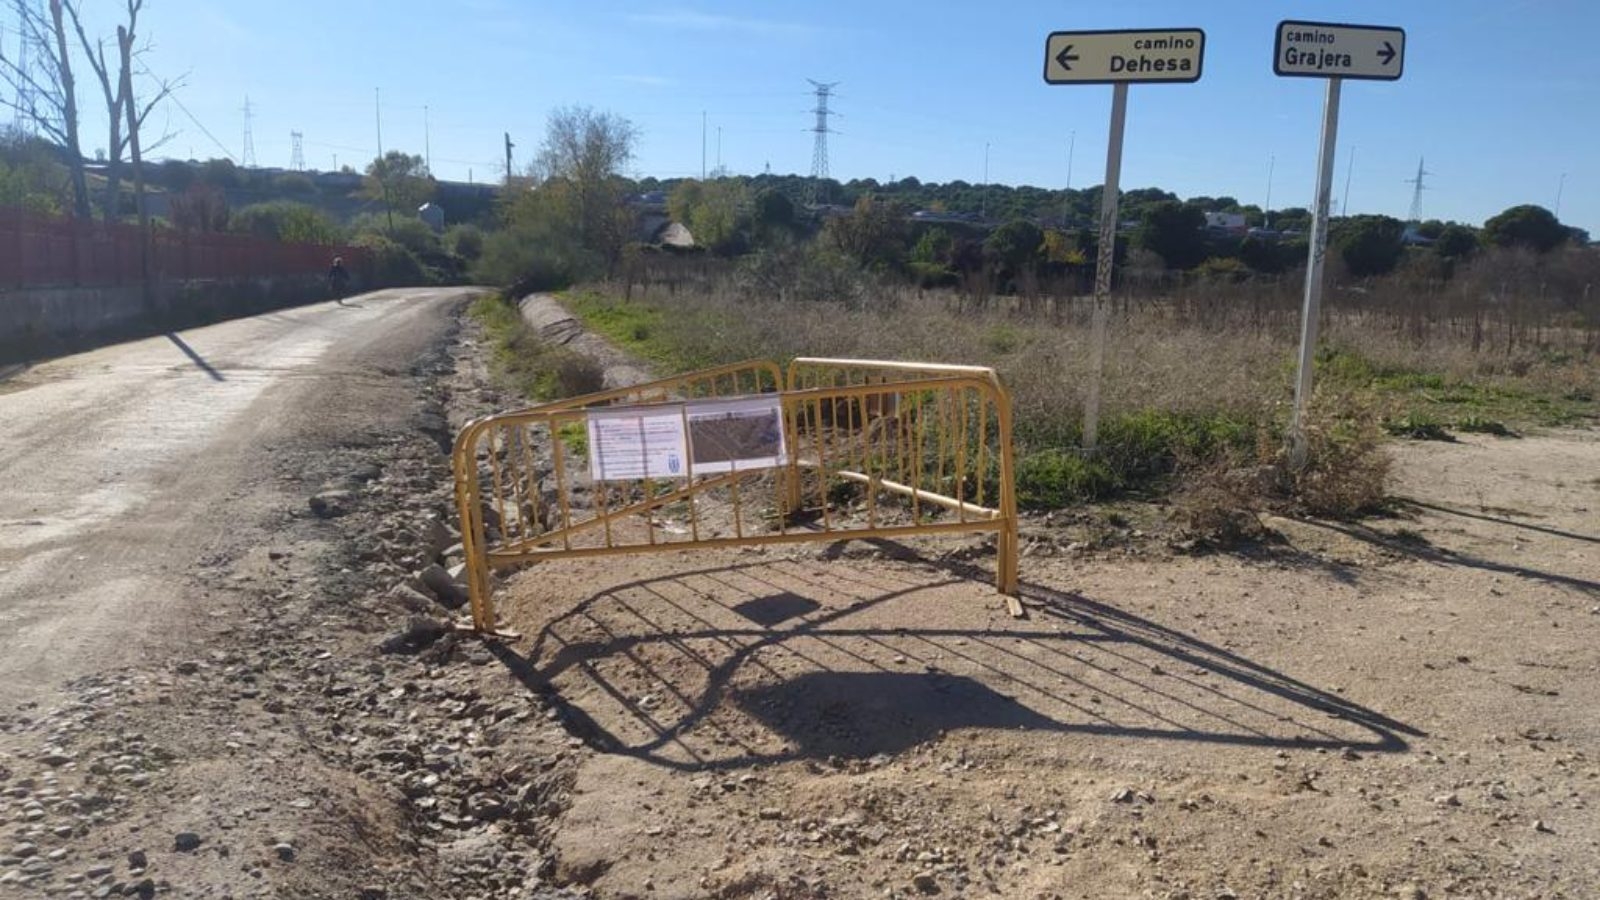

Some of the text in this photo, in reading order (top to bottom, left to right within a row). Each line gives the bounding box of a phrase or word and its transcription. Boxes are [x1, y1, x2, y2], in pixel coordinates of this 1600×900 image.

[1134, 35, 1195, 50] camino
[1286, 30, 1336, 44] camino
[1109, 54, 1192, 72] Dehesa
[1285, 47, 1352, 69] Grajera
